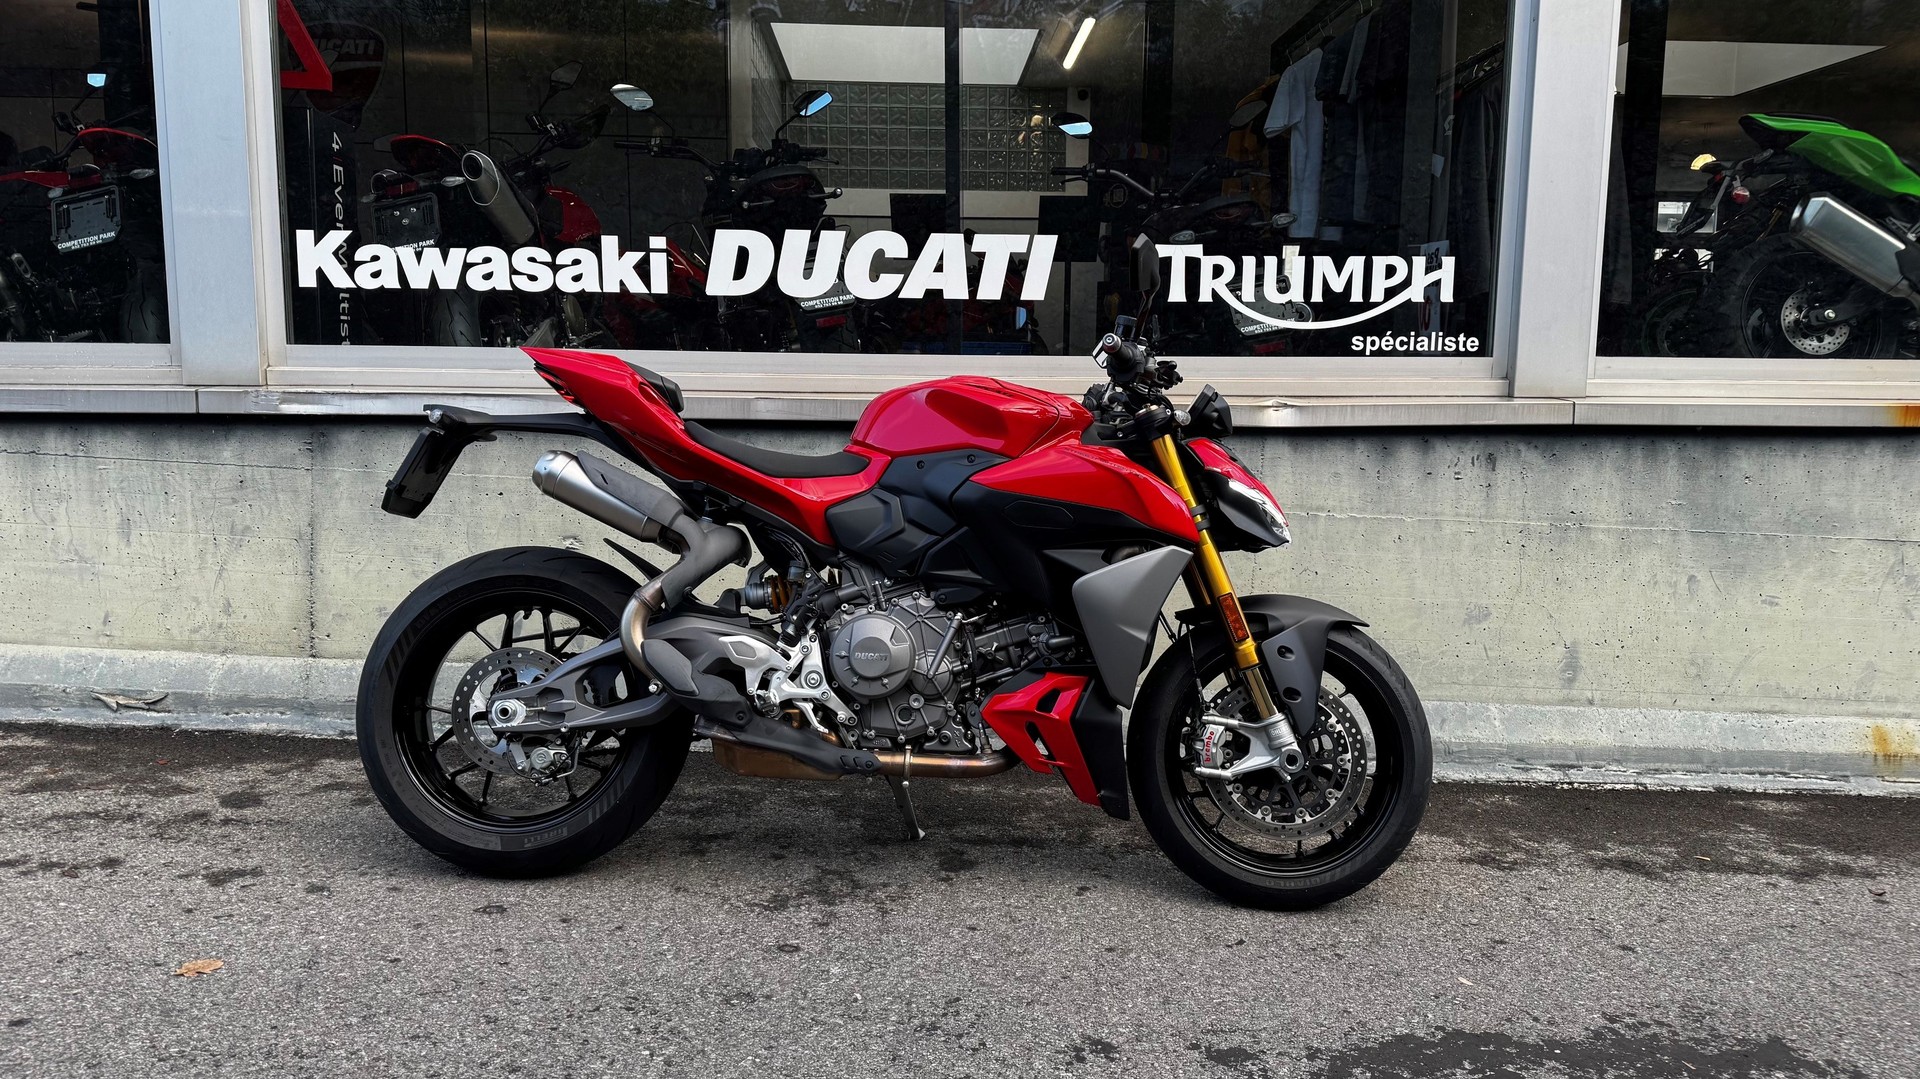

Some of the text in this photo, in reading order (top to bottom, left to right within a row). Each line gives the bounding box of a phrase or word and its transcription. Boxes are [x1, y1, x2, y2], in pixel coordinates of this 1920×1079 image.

[57, 235, 98, 249] COMPETITION
[100, 231, 116, 240] PARK
[296, 230, 667, 294] Kawasaki
[705, 229, 1059, 301] DUCATI
[1155, 243, 1455, 329] TRIUMPH
[800, 296, 839, 308] COMPETITION
[1350, 331, 1480, 356] spécialiste
[854, 651, 888, 661] DUCATI
[1204, 730, 1215, 763] brembo
